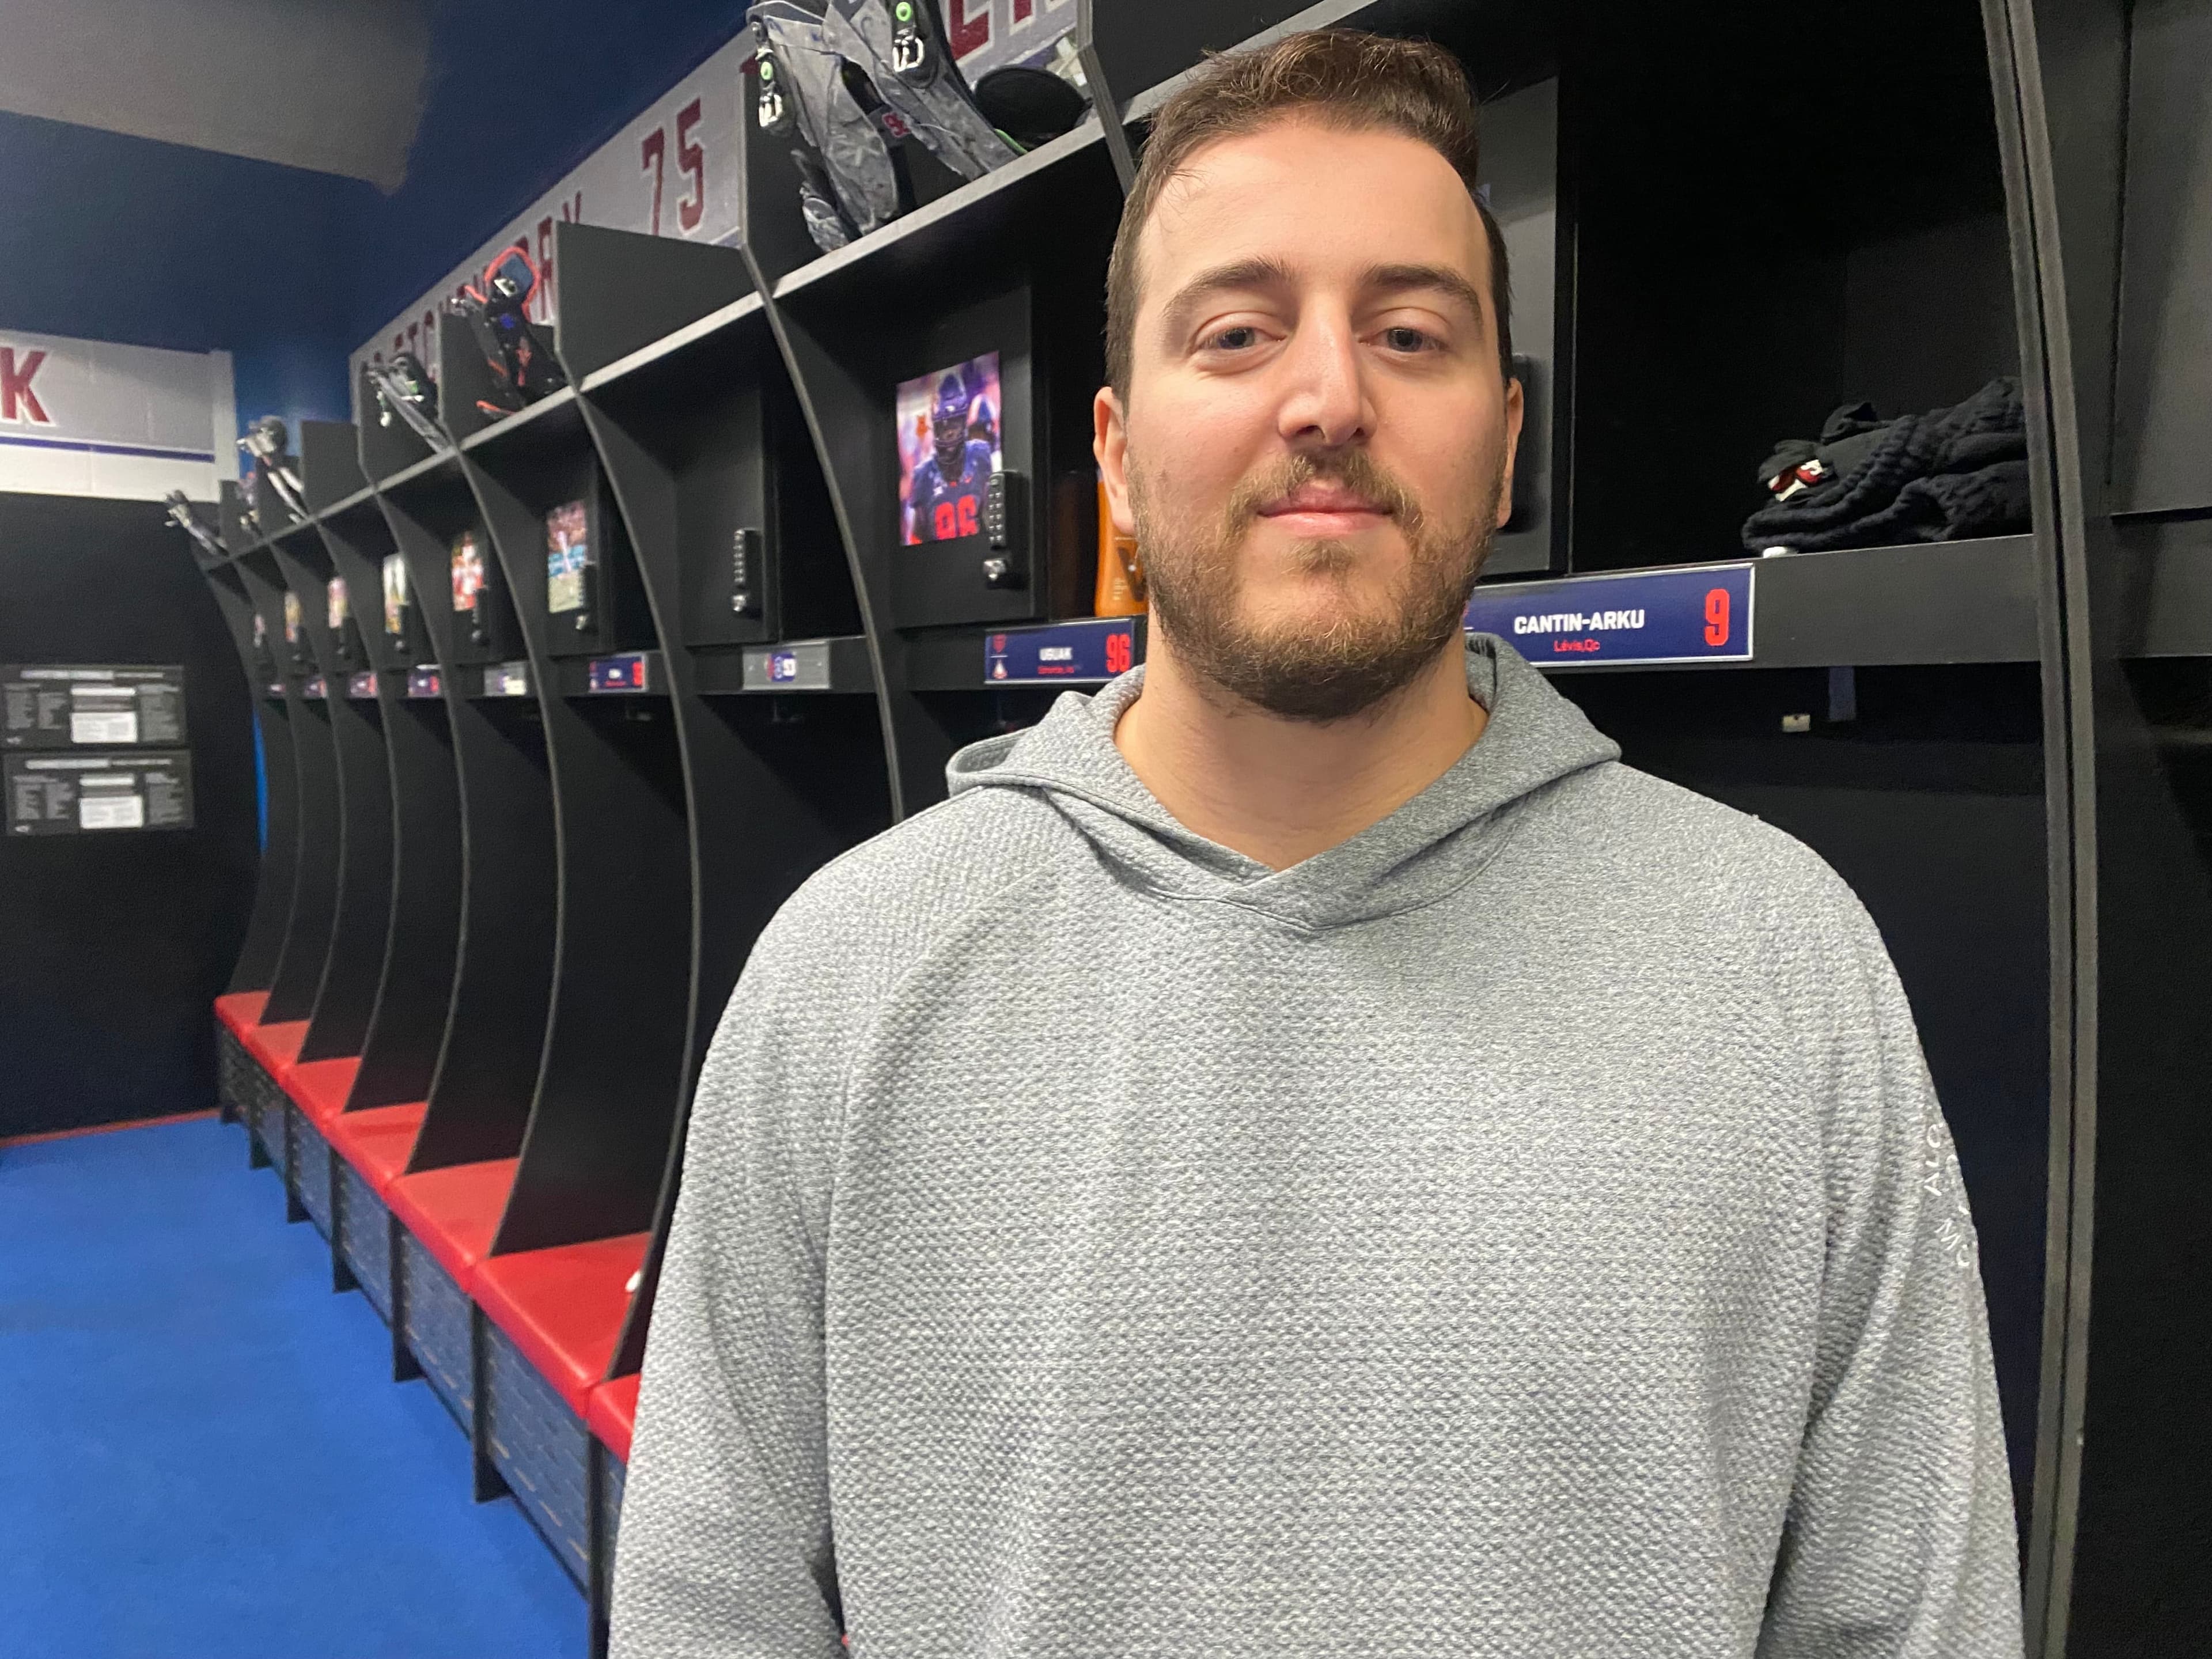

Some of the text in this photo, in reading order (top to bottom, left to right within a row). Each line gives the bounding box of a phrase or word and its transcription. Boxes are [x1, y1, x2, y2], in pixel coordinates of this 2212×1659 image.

[641, 96, 704, 236] 75
[0, 347, 50, 423] K
[1514, 609, 1645, 634] CANTIN-ARKU
[1705, 588, 1730, 646] 9
[1106, 634, 1131, 673] 96
